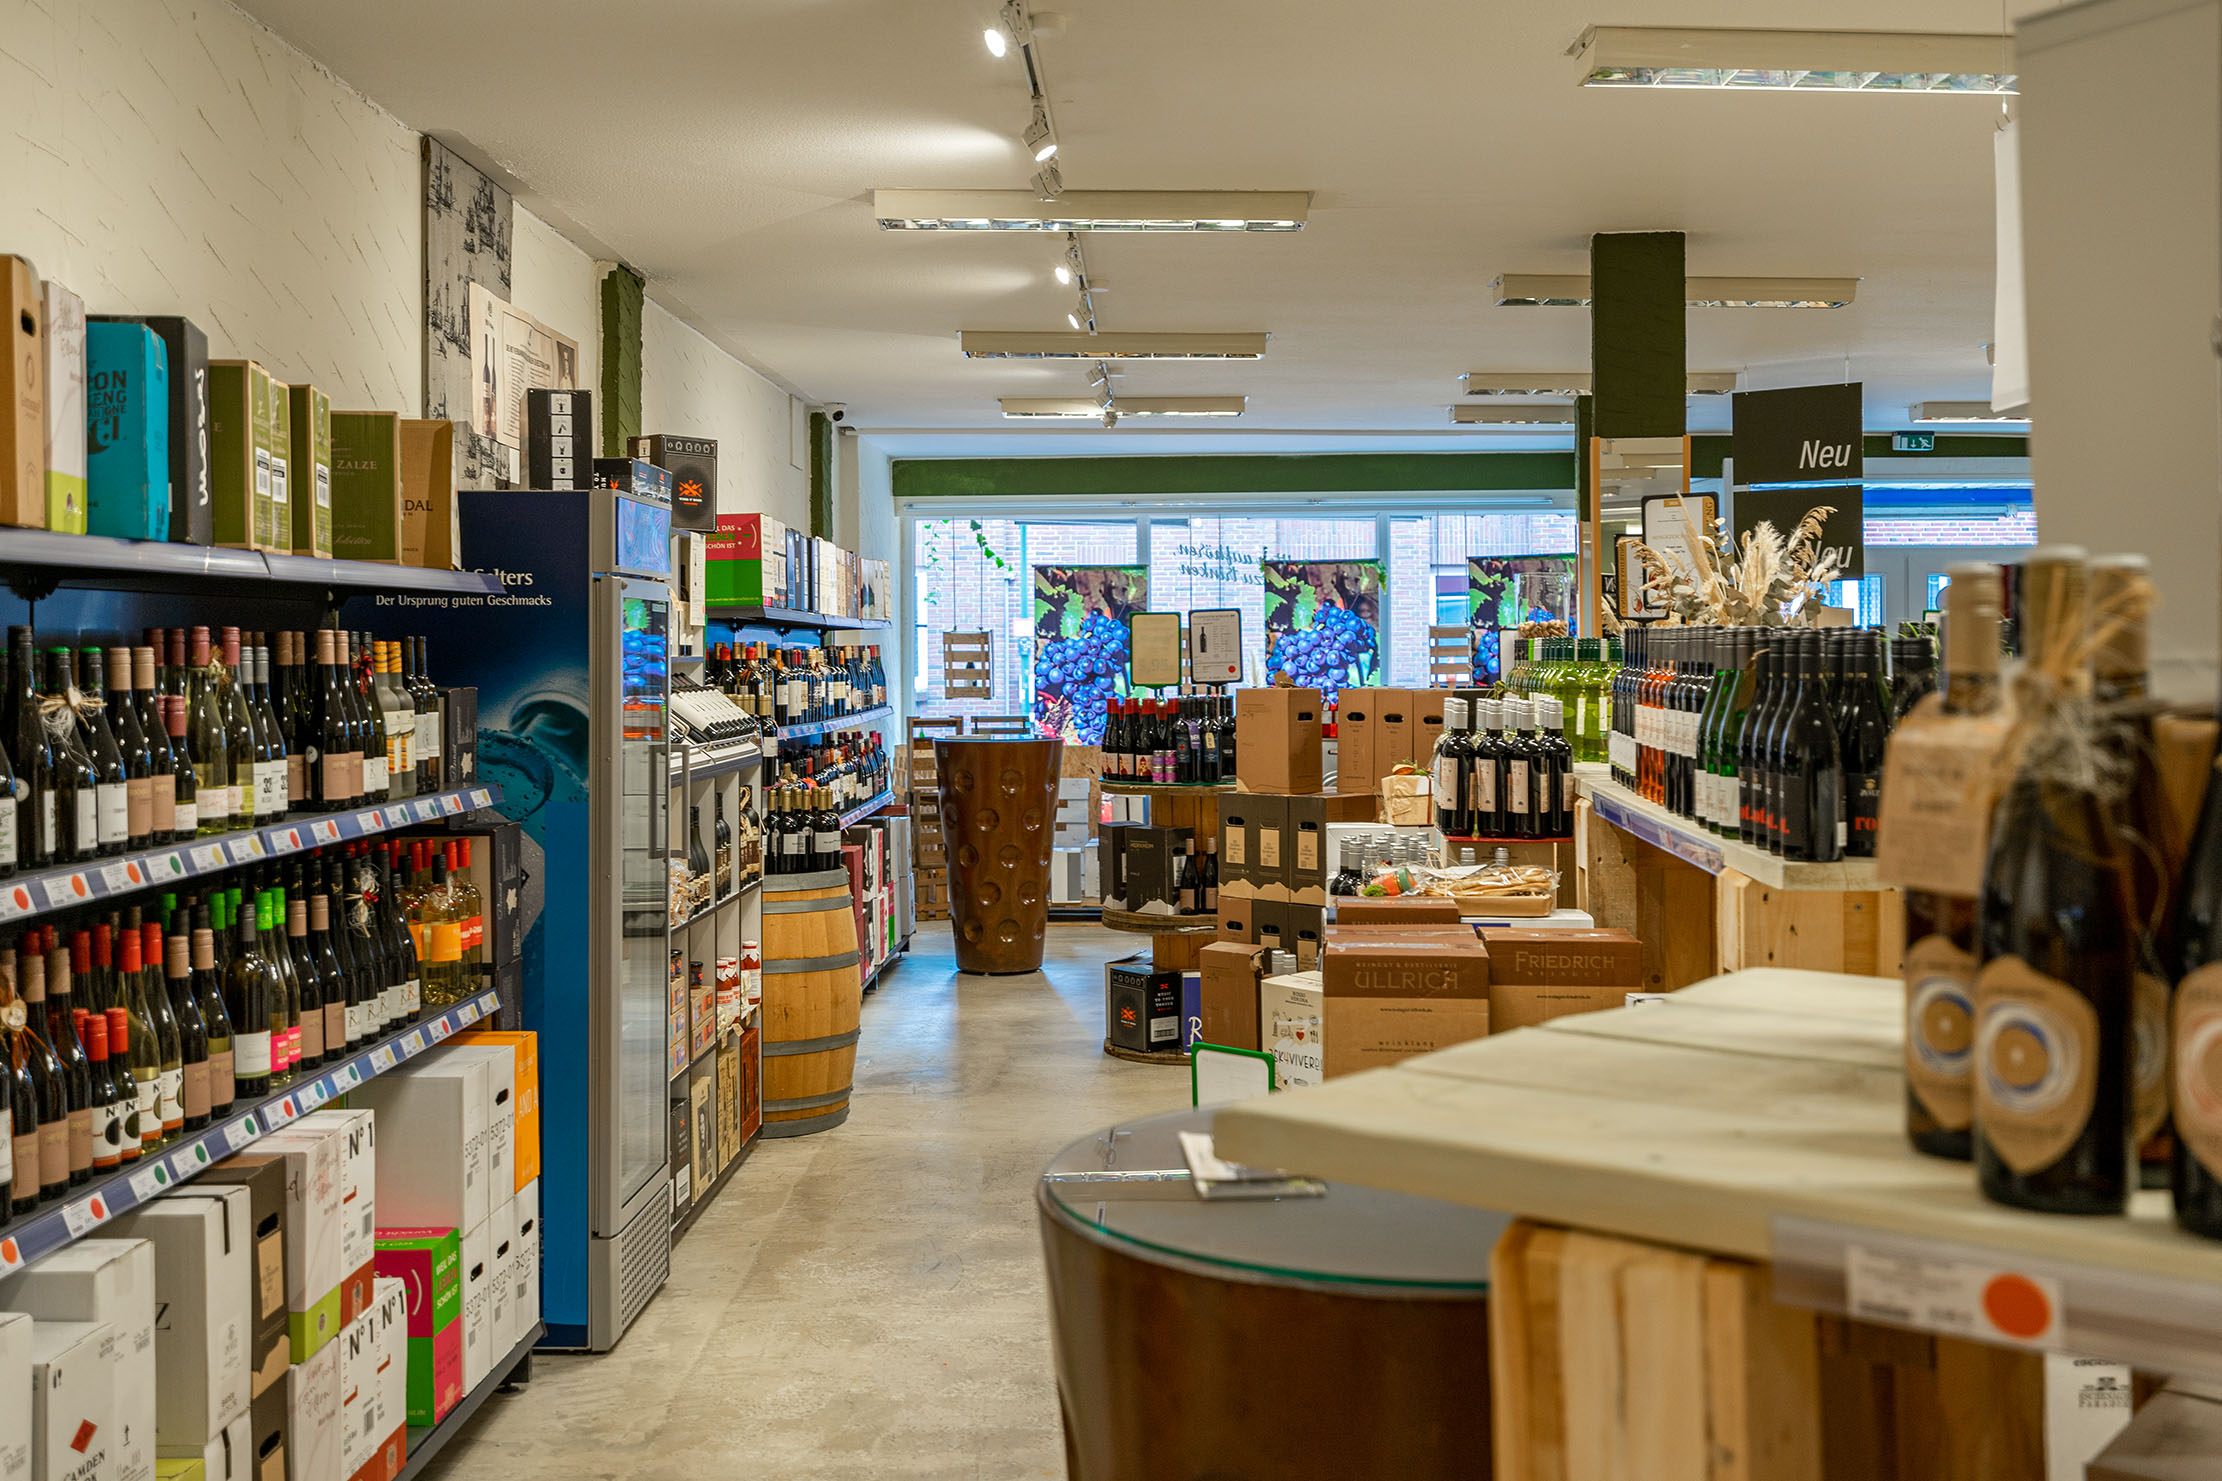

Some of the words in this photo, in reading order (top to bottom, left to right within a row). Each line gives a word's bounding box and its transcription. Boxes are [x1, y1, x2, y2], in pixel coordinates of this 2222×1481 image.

[1799, 440, 1851, 469] Neu
[337, 460, 377, 470] ZALZE
[404, 500, 433, 511] DAL
[376, 595, 395, 606] Der
[398, 595, 448, 608] Ursprung
[452, 596, 484, 608] guten
[487, 595, 552, 606] Geschmacks
[1854, 816, 1877, 831] ro
[1515, 951, 1615, 972] FRIEDRICH
[1354, 970, 1459, 990] ULLRICH
[155, 1302, 171, 1330] Z
